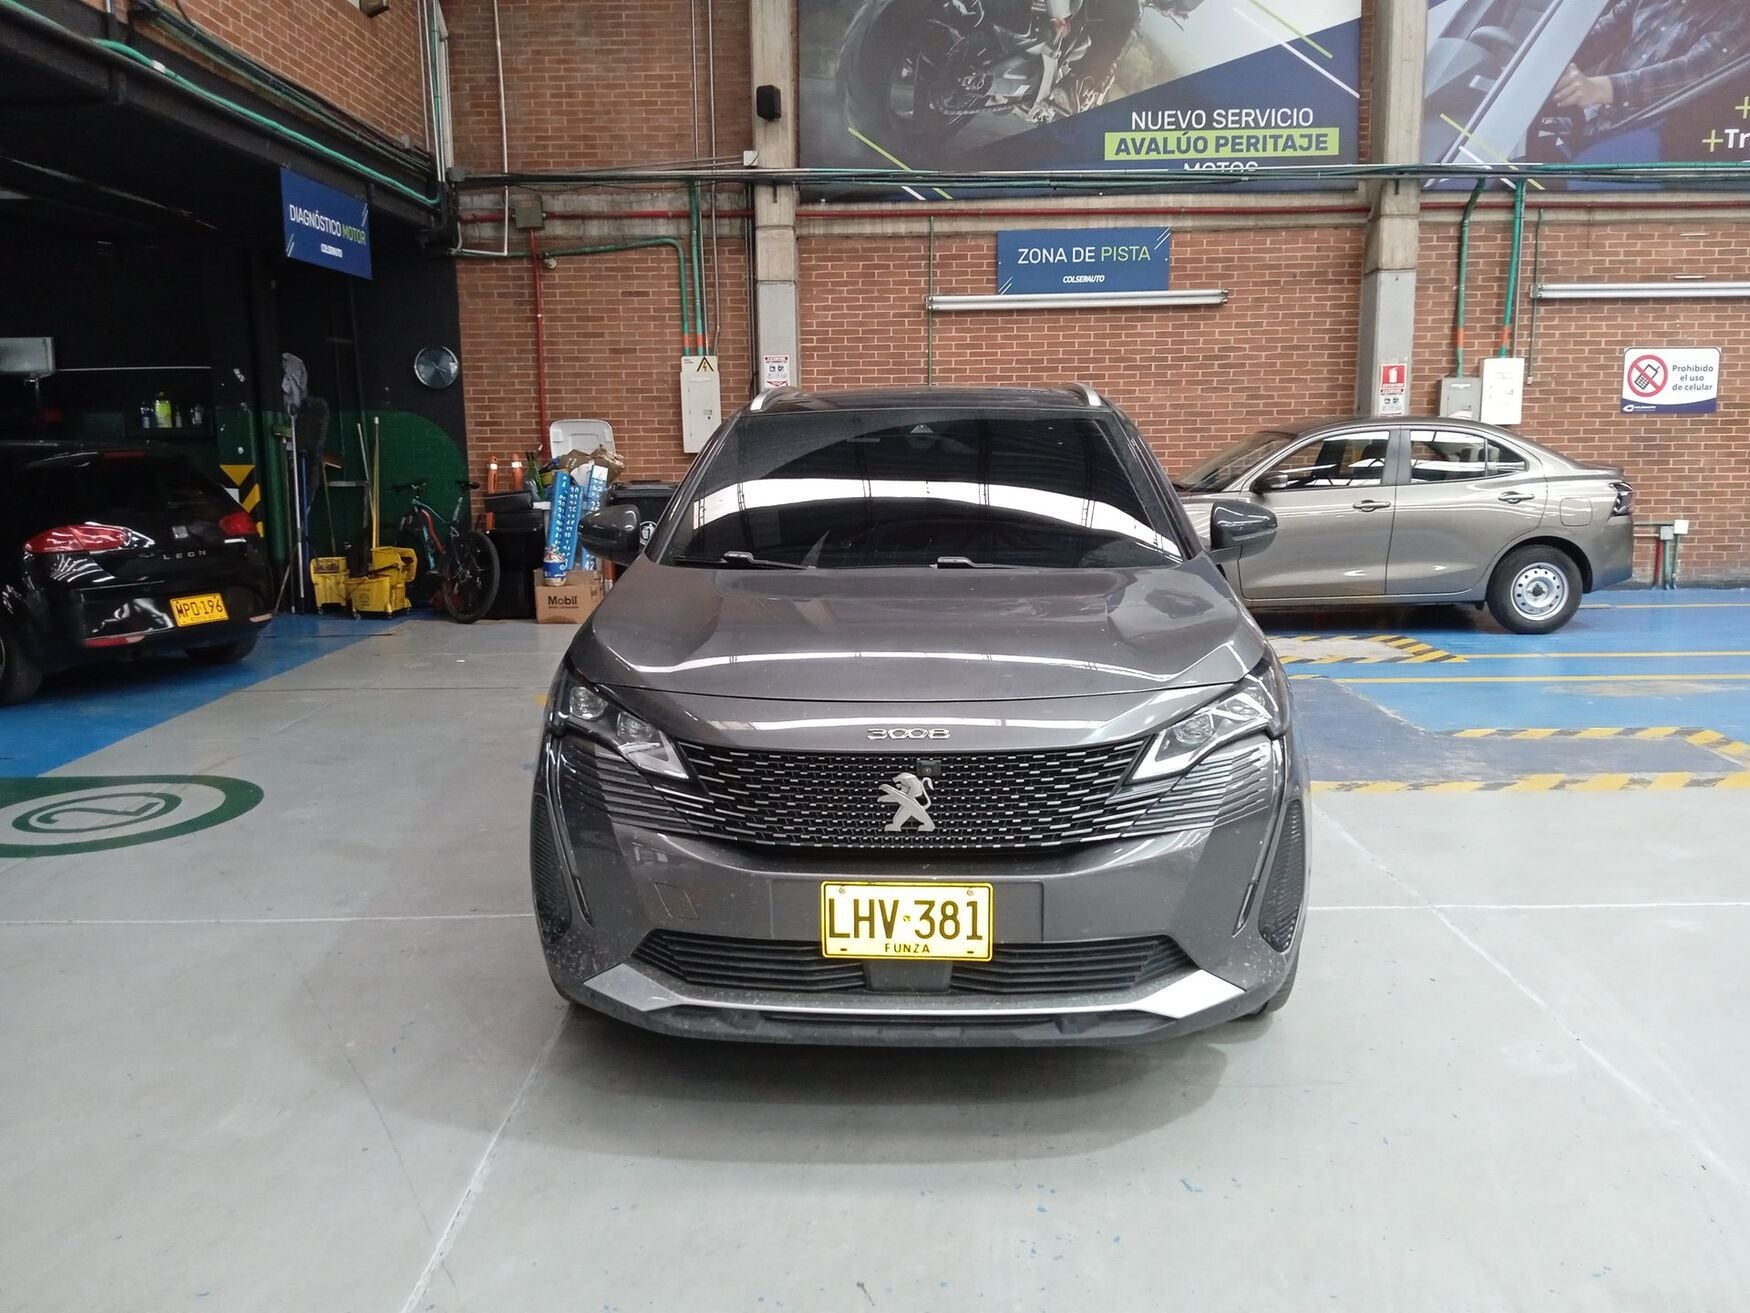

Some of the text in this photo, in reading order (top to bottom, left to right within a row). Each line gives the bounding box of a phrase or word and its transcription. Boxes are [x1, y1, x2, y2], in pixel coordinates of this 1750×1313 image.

[1131, 108, 1313, 130] NUEVO SERVICIO
[1114, 131, 1328, 156] AVALÚO PERITAJE
[289, 204, 367, 246] DIAGNÓSTICO MOTOR
[1018, 246, 1151, 264] ZONA DE PISTA
[1672, 364, 1714, 372] Prohibido
[1672, 383, 1713, 391] de celular
[547, 595, 577, 606] Mobil
[867, 728, 951, 740] 3008
[828, 898, 983, 940] LHV 381
[884, 943, 930, 954] FUNZA
